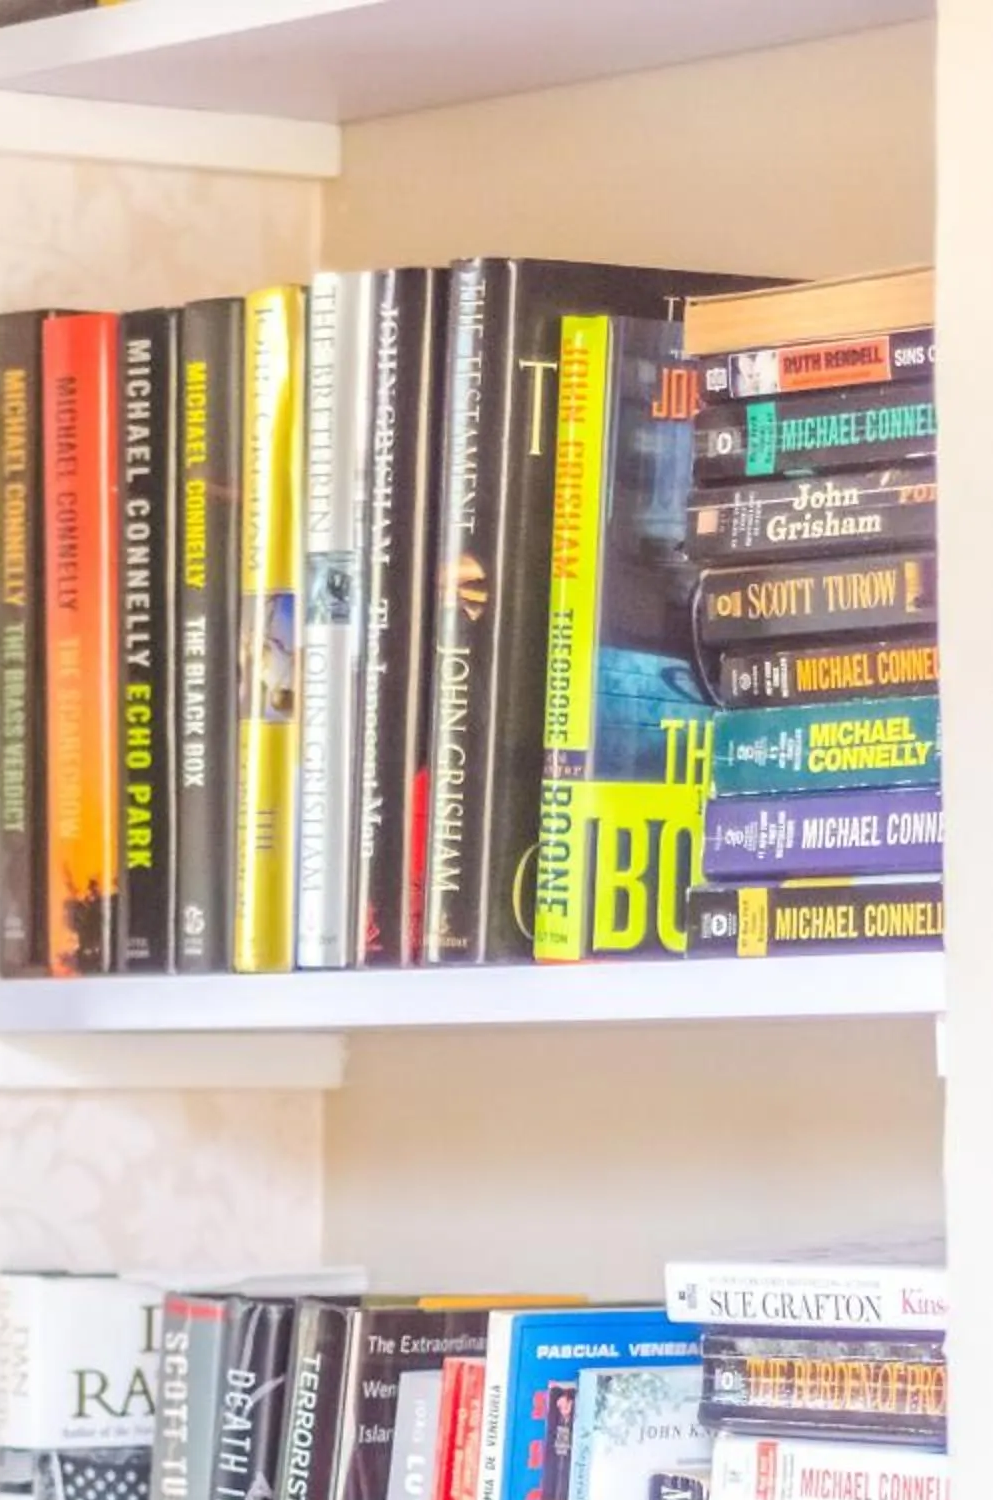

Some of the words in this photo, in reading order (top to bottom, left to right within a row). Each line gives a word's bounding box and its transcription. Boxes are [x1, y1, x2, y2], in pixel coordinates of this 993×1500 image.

[376, 302, 400, 396] JOHN
[560, 338, 590, 425] JOHN
[782, 353, 822, 375] RUTH
[824, 345, 884, 371] RENDELL
[894, 350, 925, 367] SINS
[3, 370, 26, 477] MICHAEL
[56, 375, 78, 481] MICHAEL
[126, 339, 151, 483] MICHAEL
[184, 361, 207, 468] MICHAEL
[450, 351, 483, 536] TESTAMENT
[781, 412, 862, 452] MICHAEL
[370, 405, 394, 567] GRISHAM
[553, 439, 585, 580] GRISHAM
[765, 514, 882, 543] Grisham
[792, 482, 860, 511] John
[3, 483, 26, 605] CONNELLY
[56, 492, 78, 611] CONNELLY
[184, 479, 206, 588] CONNELLY
[126, 499, 151, 667] CONNELLY
[366, 598, 389, 654] The
[747, 577, 814, 619] SCOTT
[822, 569, 898, 612] TUROW
[4, 624, 25, 661] THE
[184, 616, 206, 656] THE
[547, 608, 575, 744] THEODORE
[796, 653, 874, 692] MICHAEL
[3, 669, 25, 739] BRASS
[126, 684, 151, 769] ECHO
[183, 662, 205, 735] BLACK
[363, 662, 387, 787] Innocent
[436, 645, 471, 733] JOHN
[183, 743, 205, 788] BOX
[808, 741, 933, 773] CONNELLY
[810, 718, 916, 747] MICHAEL
[3, 743, 25, 832] VERDICT
[126, 785, 152, 869] PARK
[361, 795, 383, 859] Man
[432, 744, 467, 894] GRISHAM
[536, 785, 573, 918] BOONE
[802, 816, 880, 849] MICHAEL
[775, 905, 858, 940] MICHAEL
[367, 1336, 396, 1355] The
[709, 1290, 757, 1319] SUE
[761, 1290, 884, 1323] GRAFTON
[162, 1331, 193, 1444] SCOTT
[216, 1367, 256, 1474] DEATH
